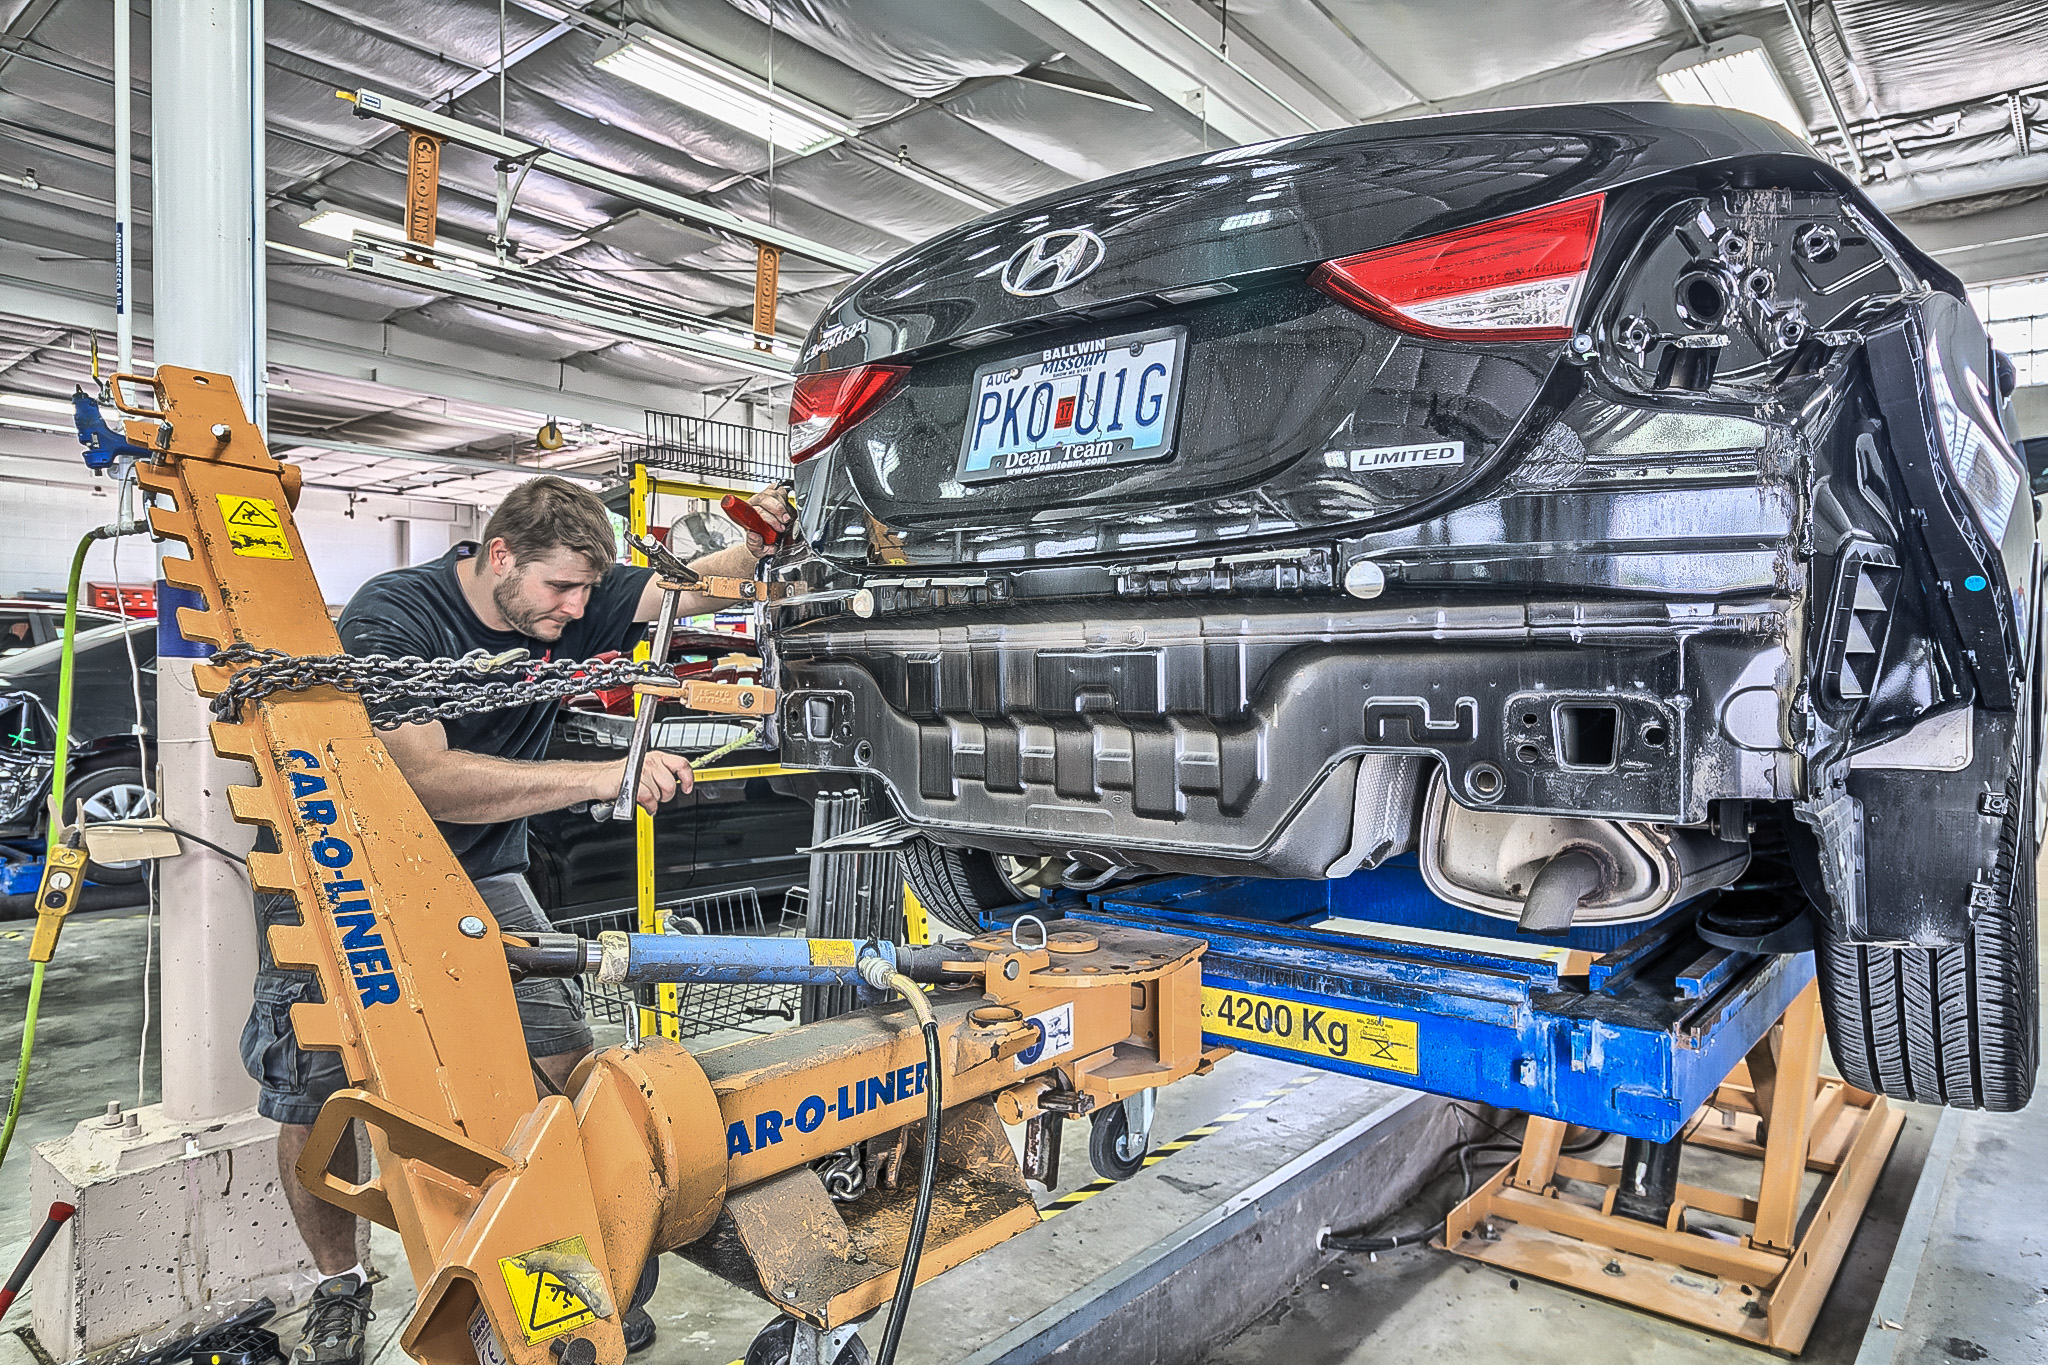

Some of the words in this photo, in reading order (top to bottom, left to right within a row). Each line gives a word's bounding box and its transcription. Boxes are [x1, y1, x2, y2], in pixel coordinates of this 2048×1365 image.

[413, 141, 433, 243] CAR-O-LINE
[1042, 338, 1107, 362] BALLWIN
[986, 372, 1011, 387] AUG
[1060, 403, 1072, 419] 17
[1004, 450, 1051, 469] Dean
[1062, 441, 1114, 460] Team
[1006, 457, 1108, 476] www.deanteam.com
[1358, 447, 1455, 466] LIMITED
[286, 749, 401, 1010] CAR-O-LINER
[1217, 994, 1293, 1037] 4200
[1302, 1008, 1349, 1056] Kg
